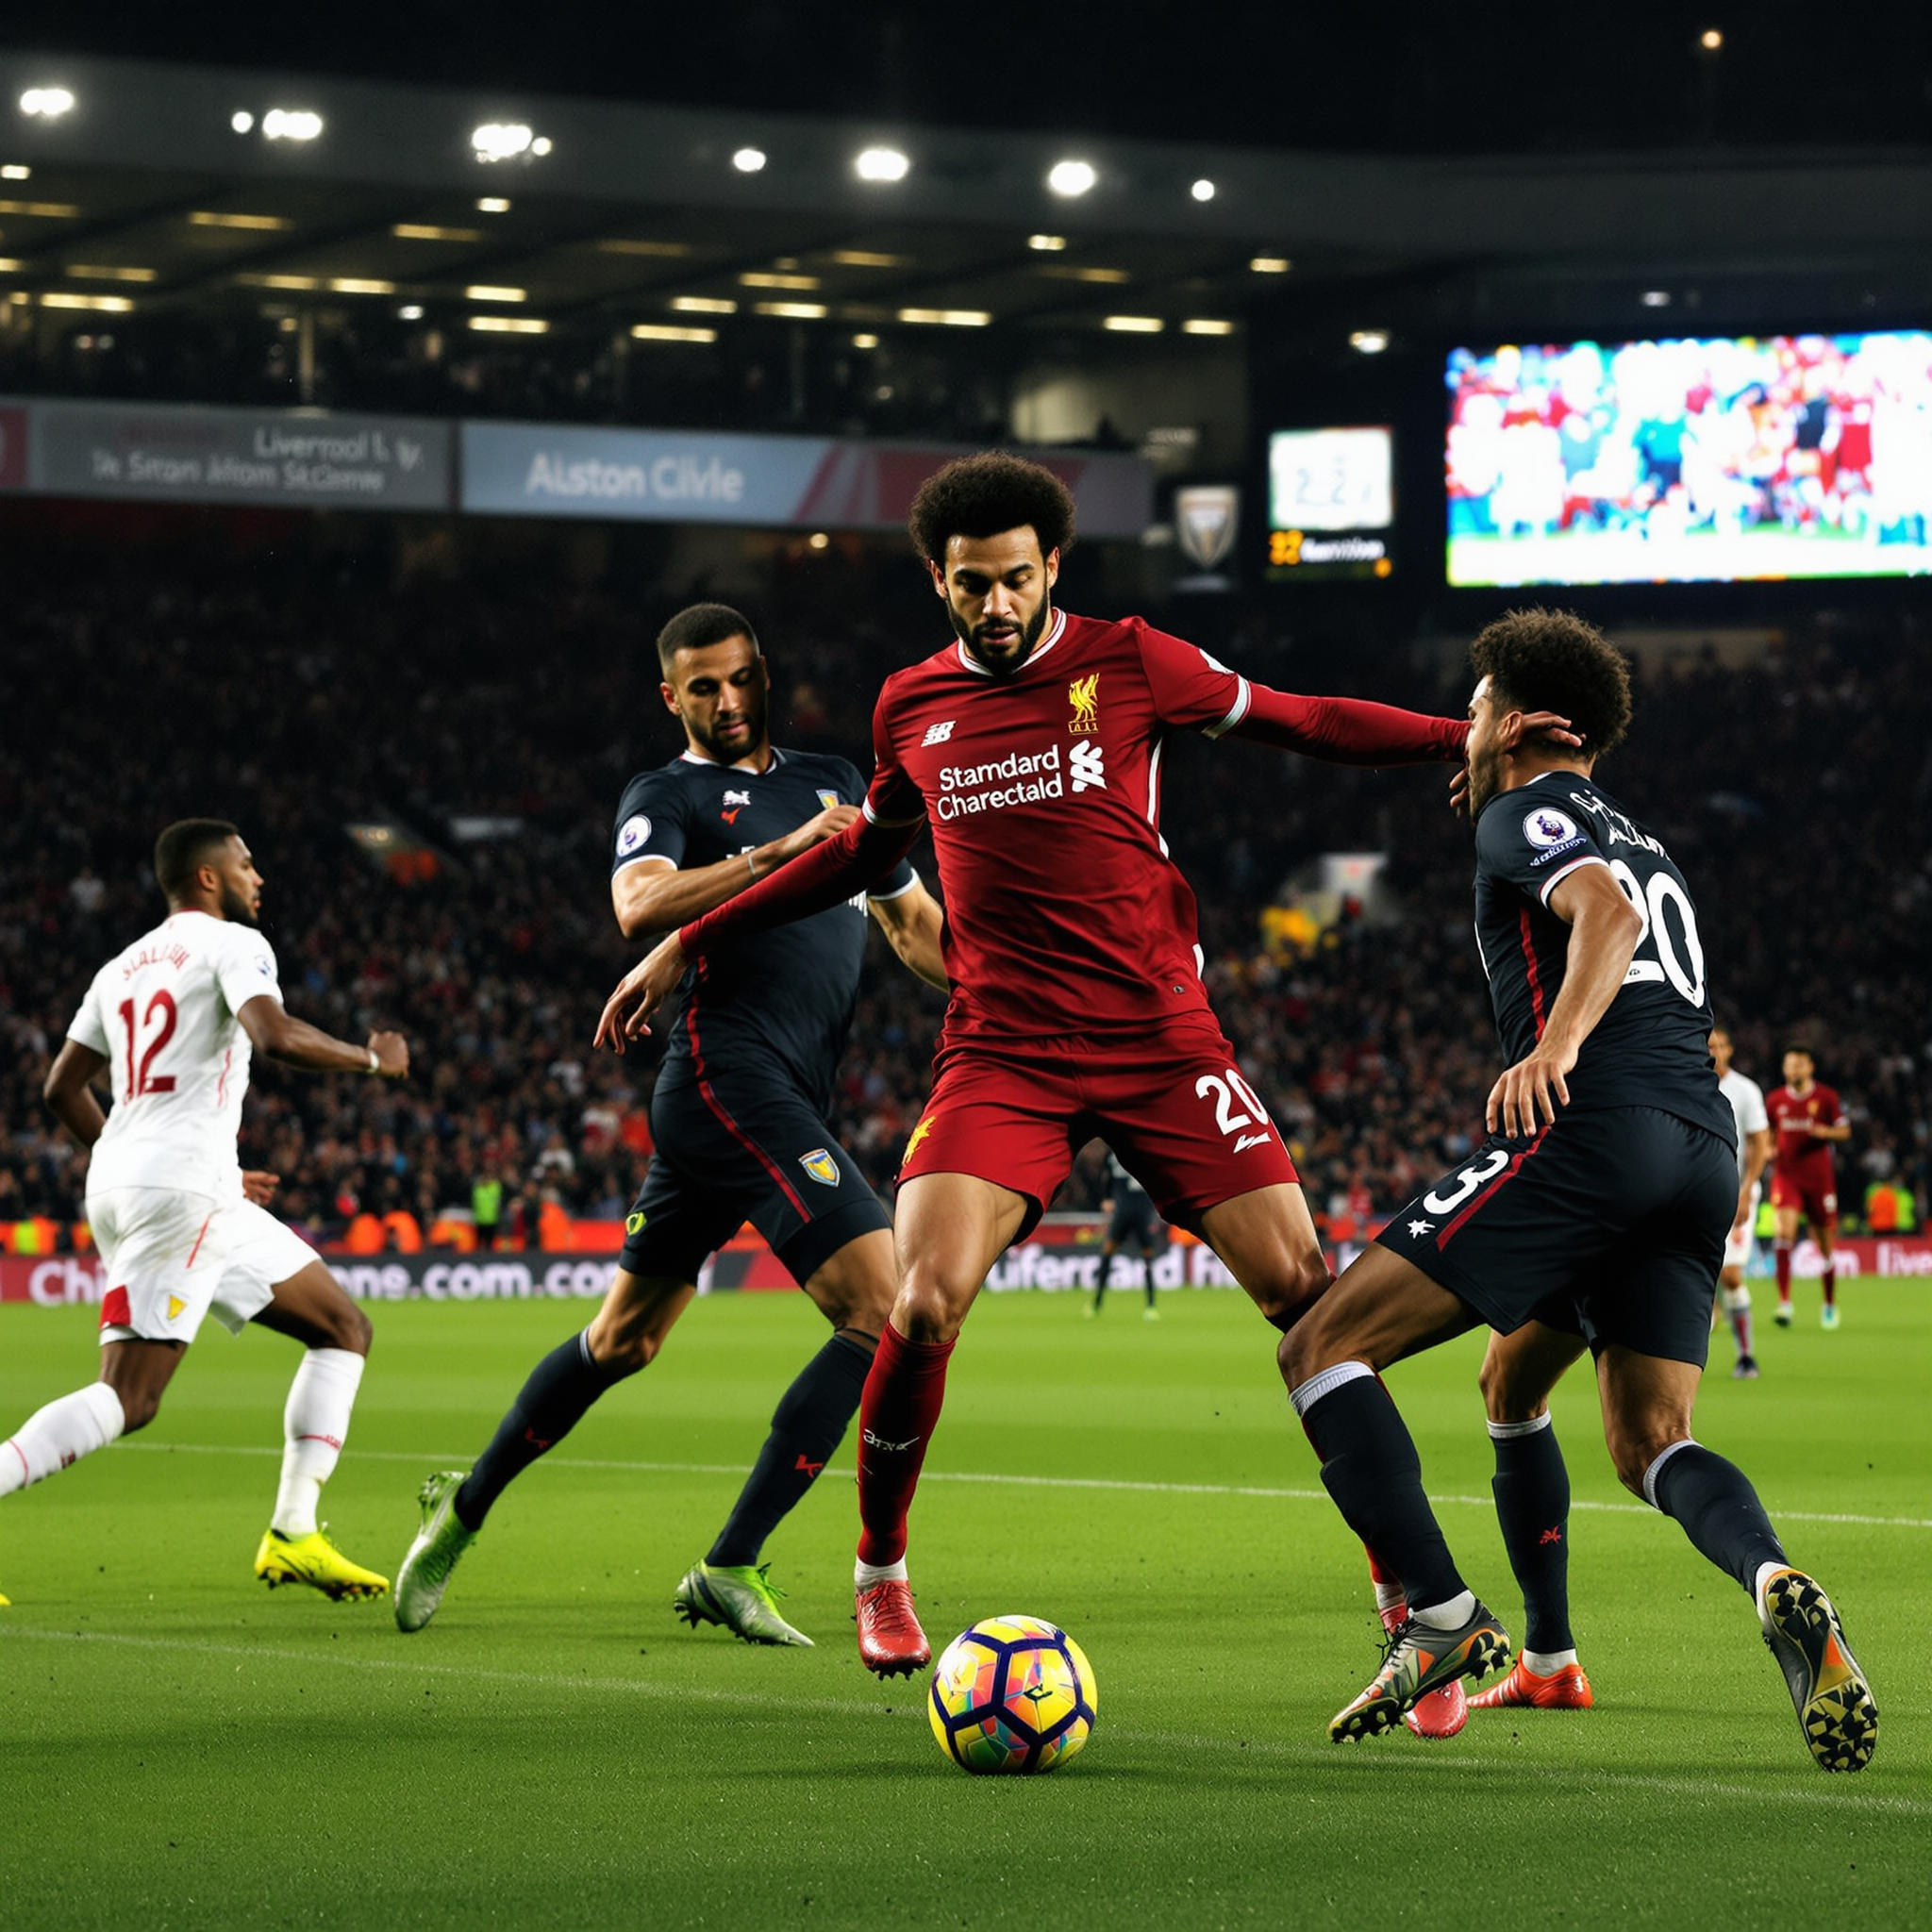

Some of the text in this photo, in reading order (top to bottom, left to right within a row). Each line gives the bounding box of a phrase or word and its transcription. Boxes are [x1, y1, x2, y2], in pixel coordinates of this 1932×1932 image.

[937, 774, 1063, 821] Charectald
[939, 744, 1060, 791] Stamdard
[118, 988, 177, 1102] 12
[1194, 1068, 1270, 1136] 20
[1423, 1149, 1510, 1215] 3
